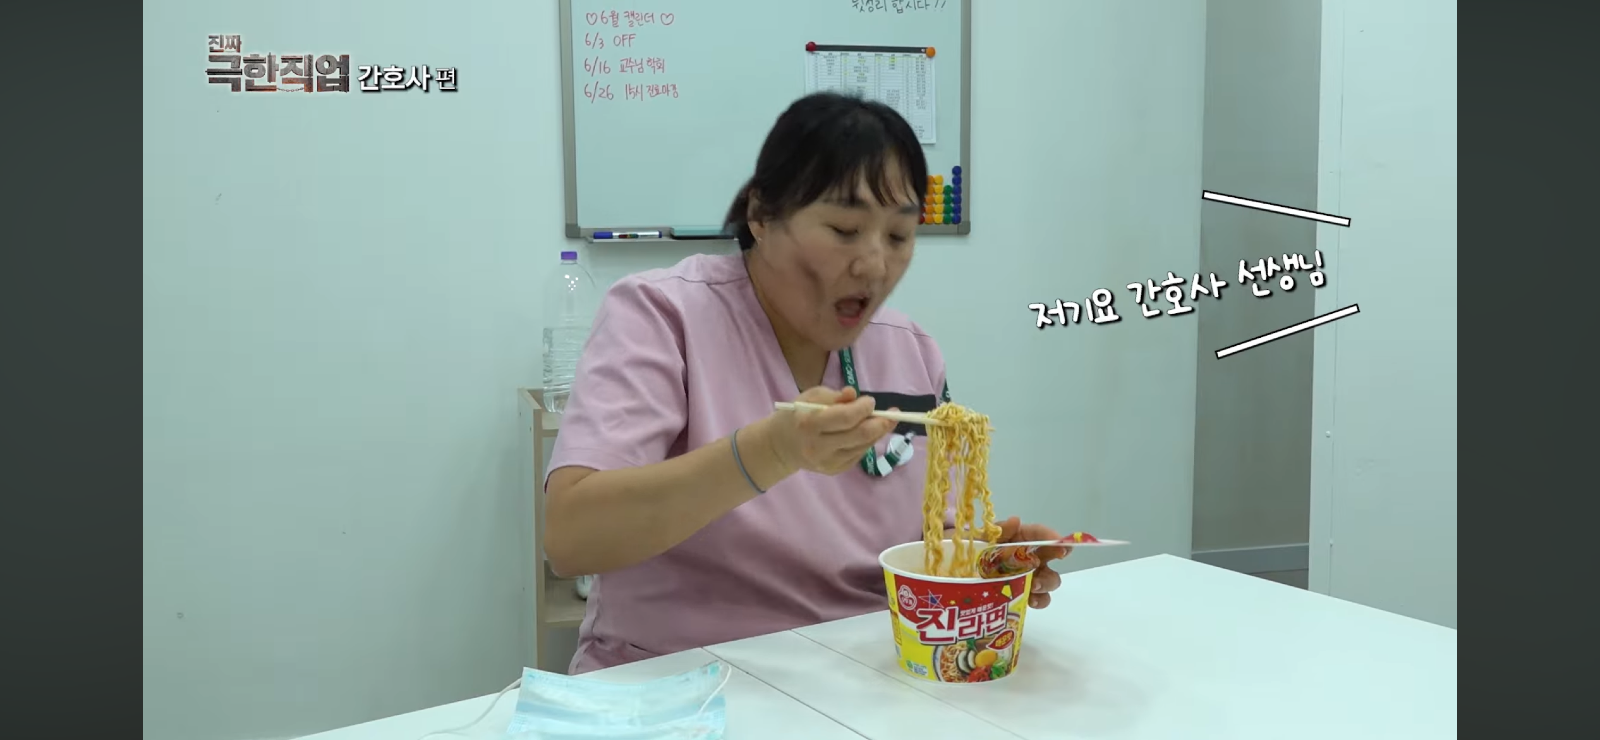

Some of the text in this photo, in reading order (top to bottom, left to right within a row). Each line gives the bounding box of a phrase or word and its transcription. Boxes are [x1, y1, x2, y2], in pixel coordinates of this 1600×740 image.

[600, 10, 655, 28] 6월 캘린더
[584, 32, 637, 49] 6/3 OFF
[584, 56, 665, 77] 6/16 교수님 학회
[584, 81, 614, 104] 6/26
[915, 602, 1008, 645] 진라면
